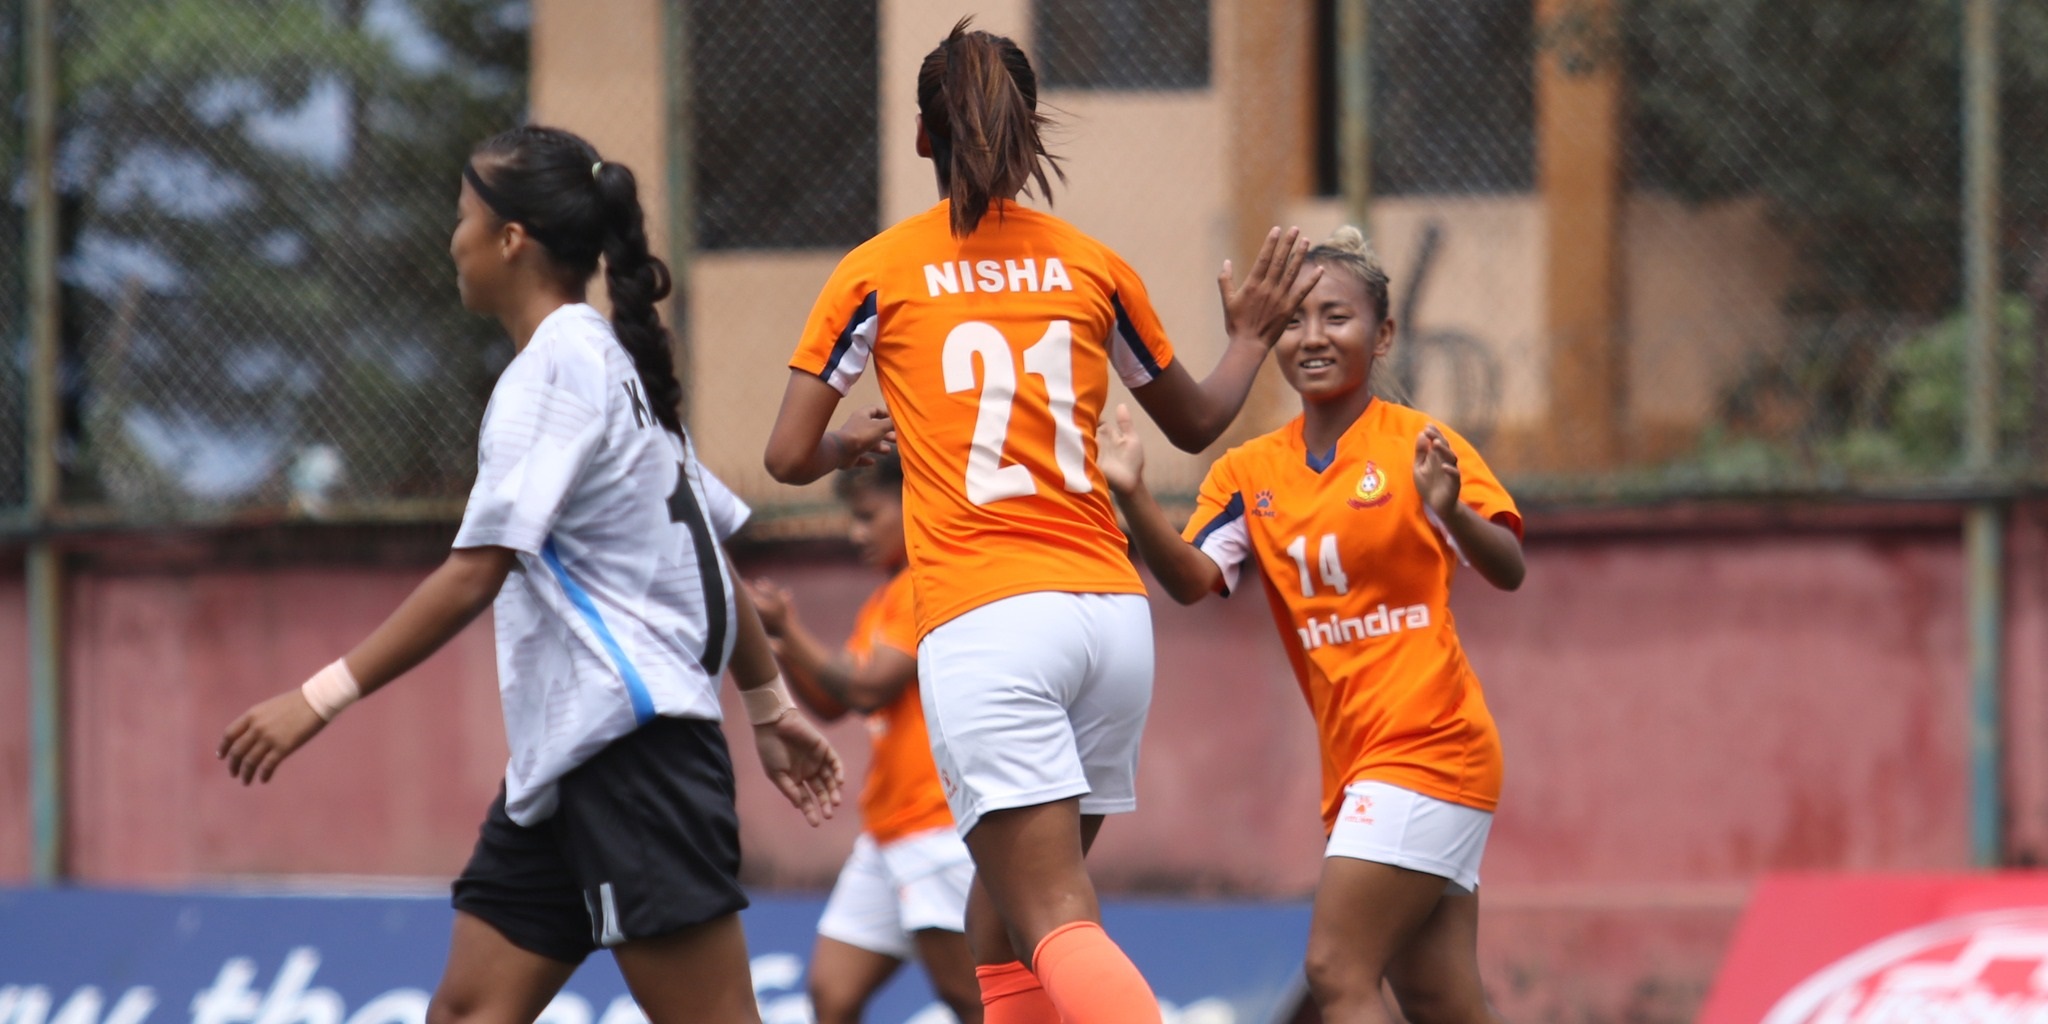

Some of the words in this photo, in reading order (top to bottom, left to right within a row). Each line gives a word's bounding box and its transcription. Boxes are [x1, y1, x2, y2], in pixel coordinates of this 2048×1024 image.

[923, 258, 1073, 297] NISHA
[942, 320, 1093, 506] 21
[1286, 533, 1348, 598] 14
